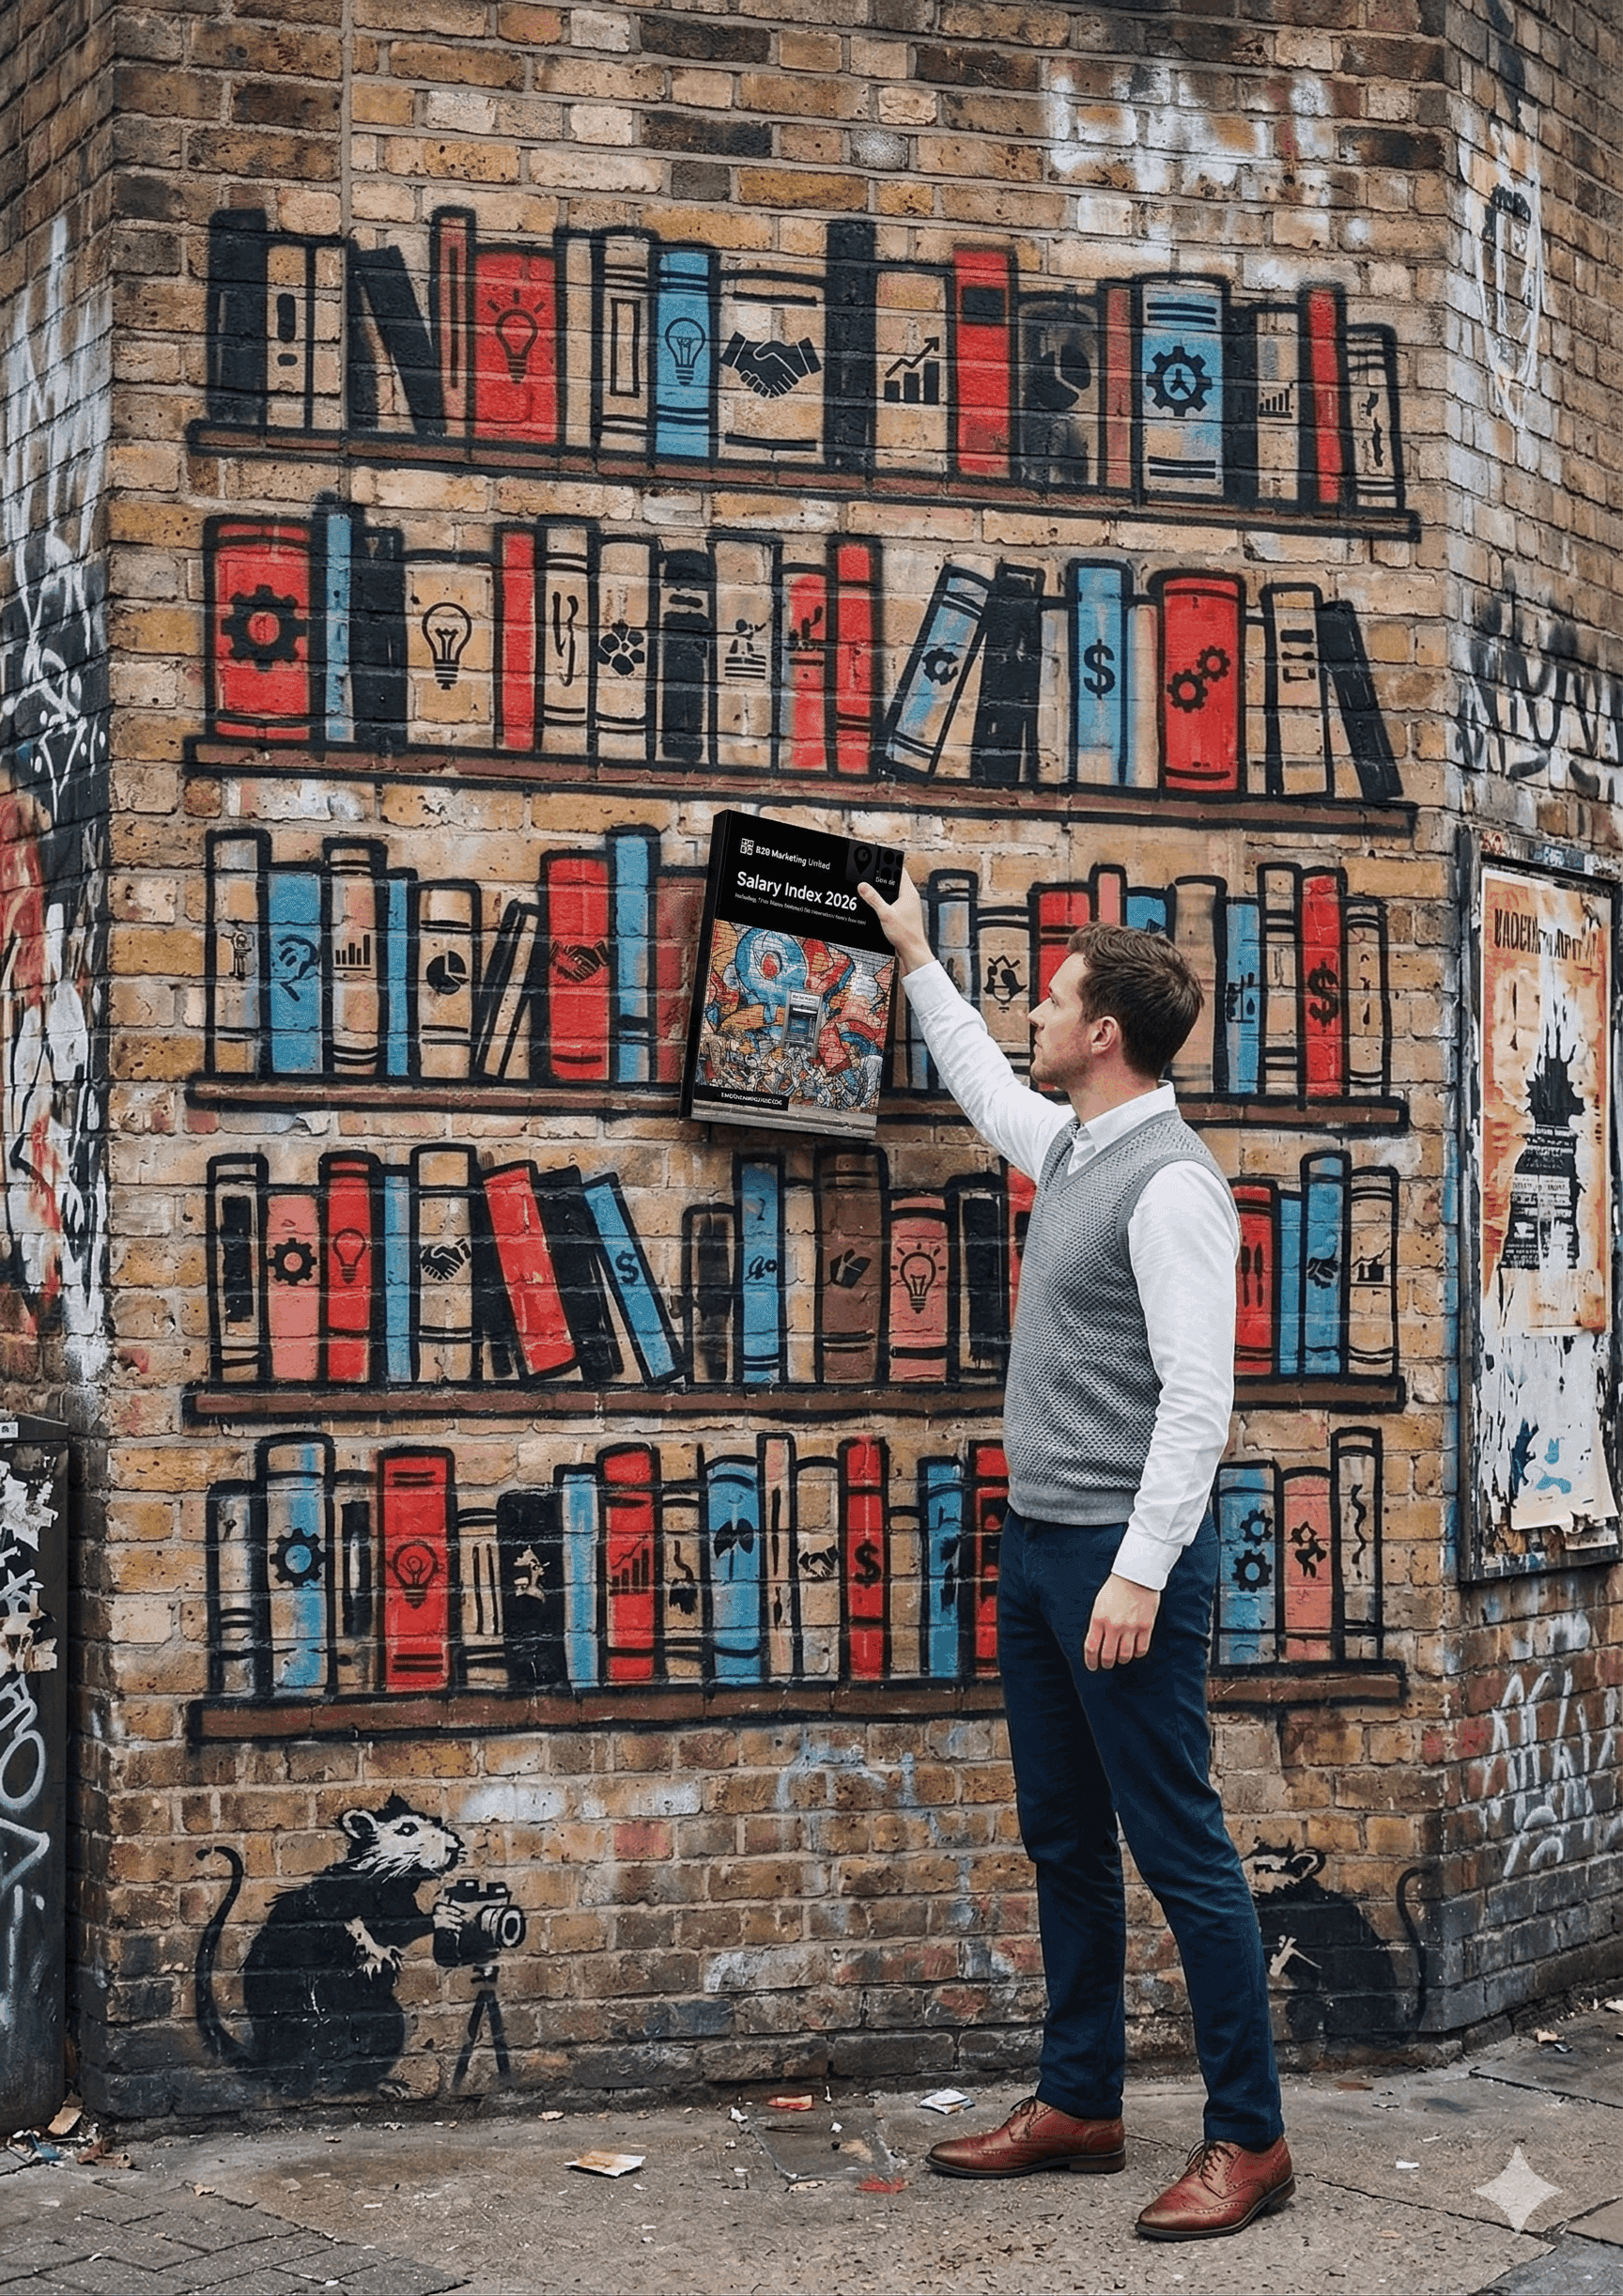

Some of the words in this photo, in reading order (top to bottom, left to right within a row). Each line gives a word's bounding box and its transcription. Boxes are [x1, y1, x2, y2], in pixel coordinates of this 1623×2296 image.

[771, 849, 807, 867] Marketing
[736, 871, 782, 897] Salary
[784, 882, 823, 903] Index
[825, 891, 858, 911] 2026
